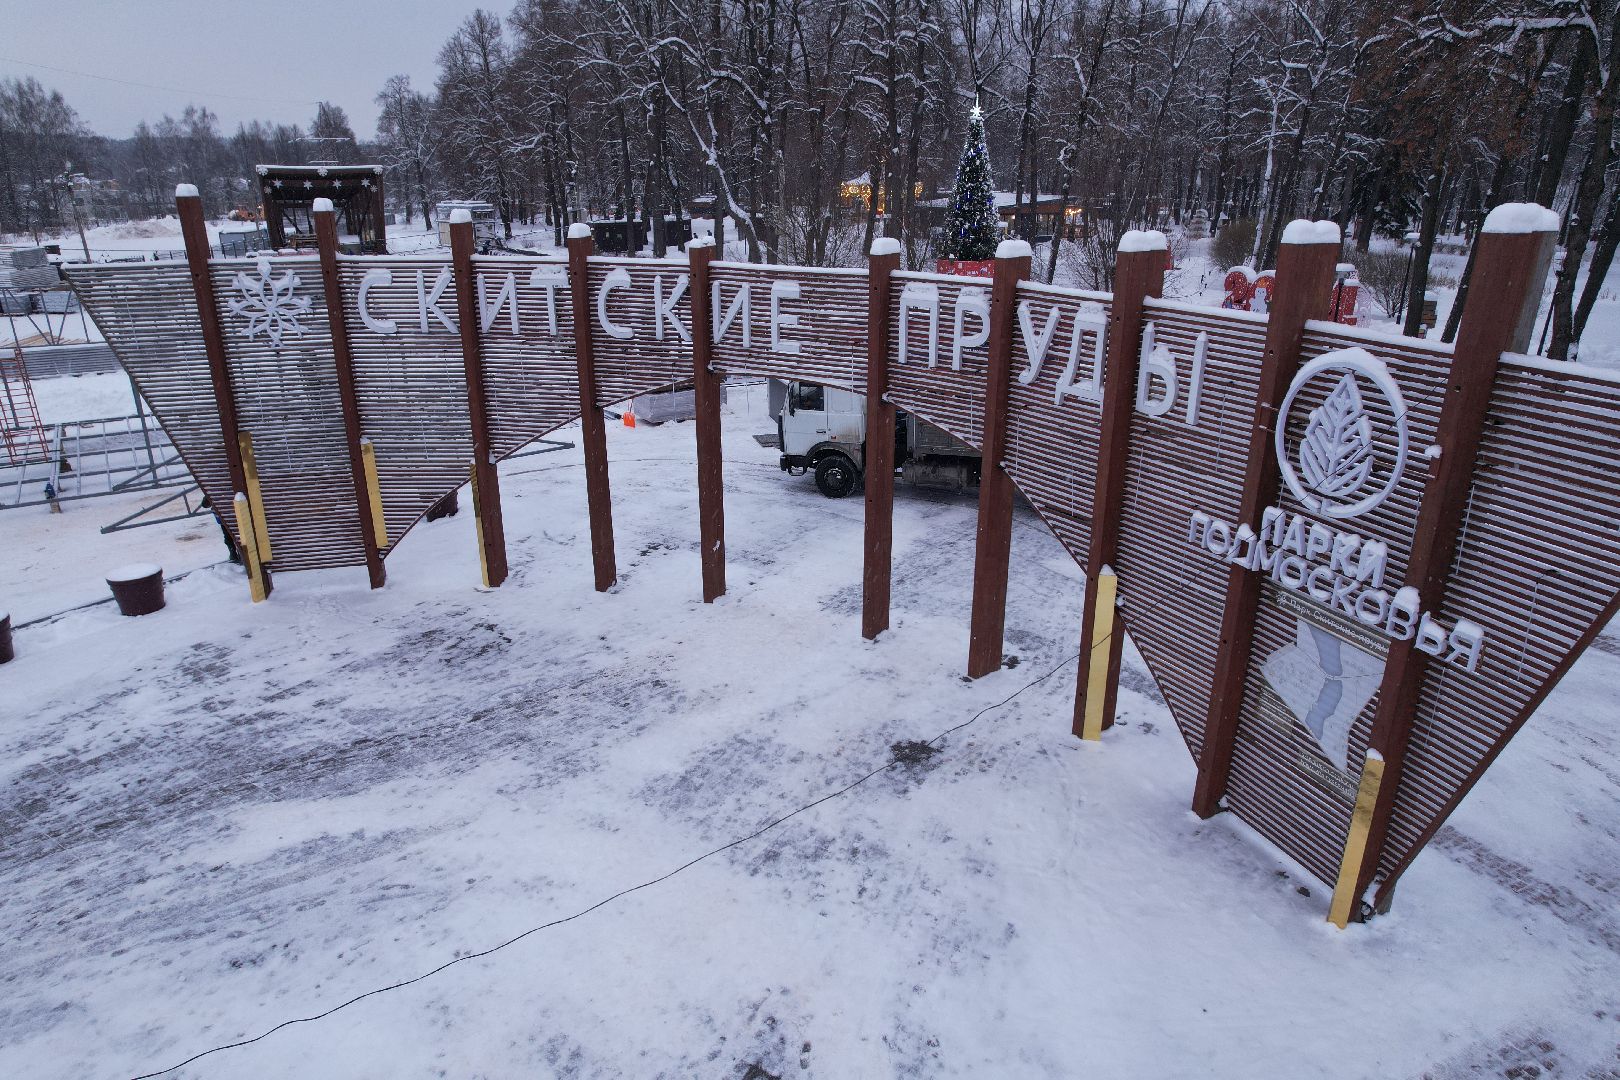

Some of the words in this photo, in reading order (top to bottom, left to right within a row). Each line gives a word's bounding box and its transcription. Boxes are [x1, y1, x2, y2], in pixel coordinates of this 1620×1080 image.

[357, 266, 802, 353] СКИТСКИЕ
[899, 282, 1208, 426] ПРУДЫ
[1188, 510, 1484, 673] ПОДМОСКОВЬЯ
[1260, 506, 1388, 588] ПАРКИ
